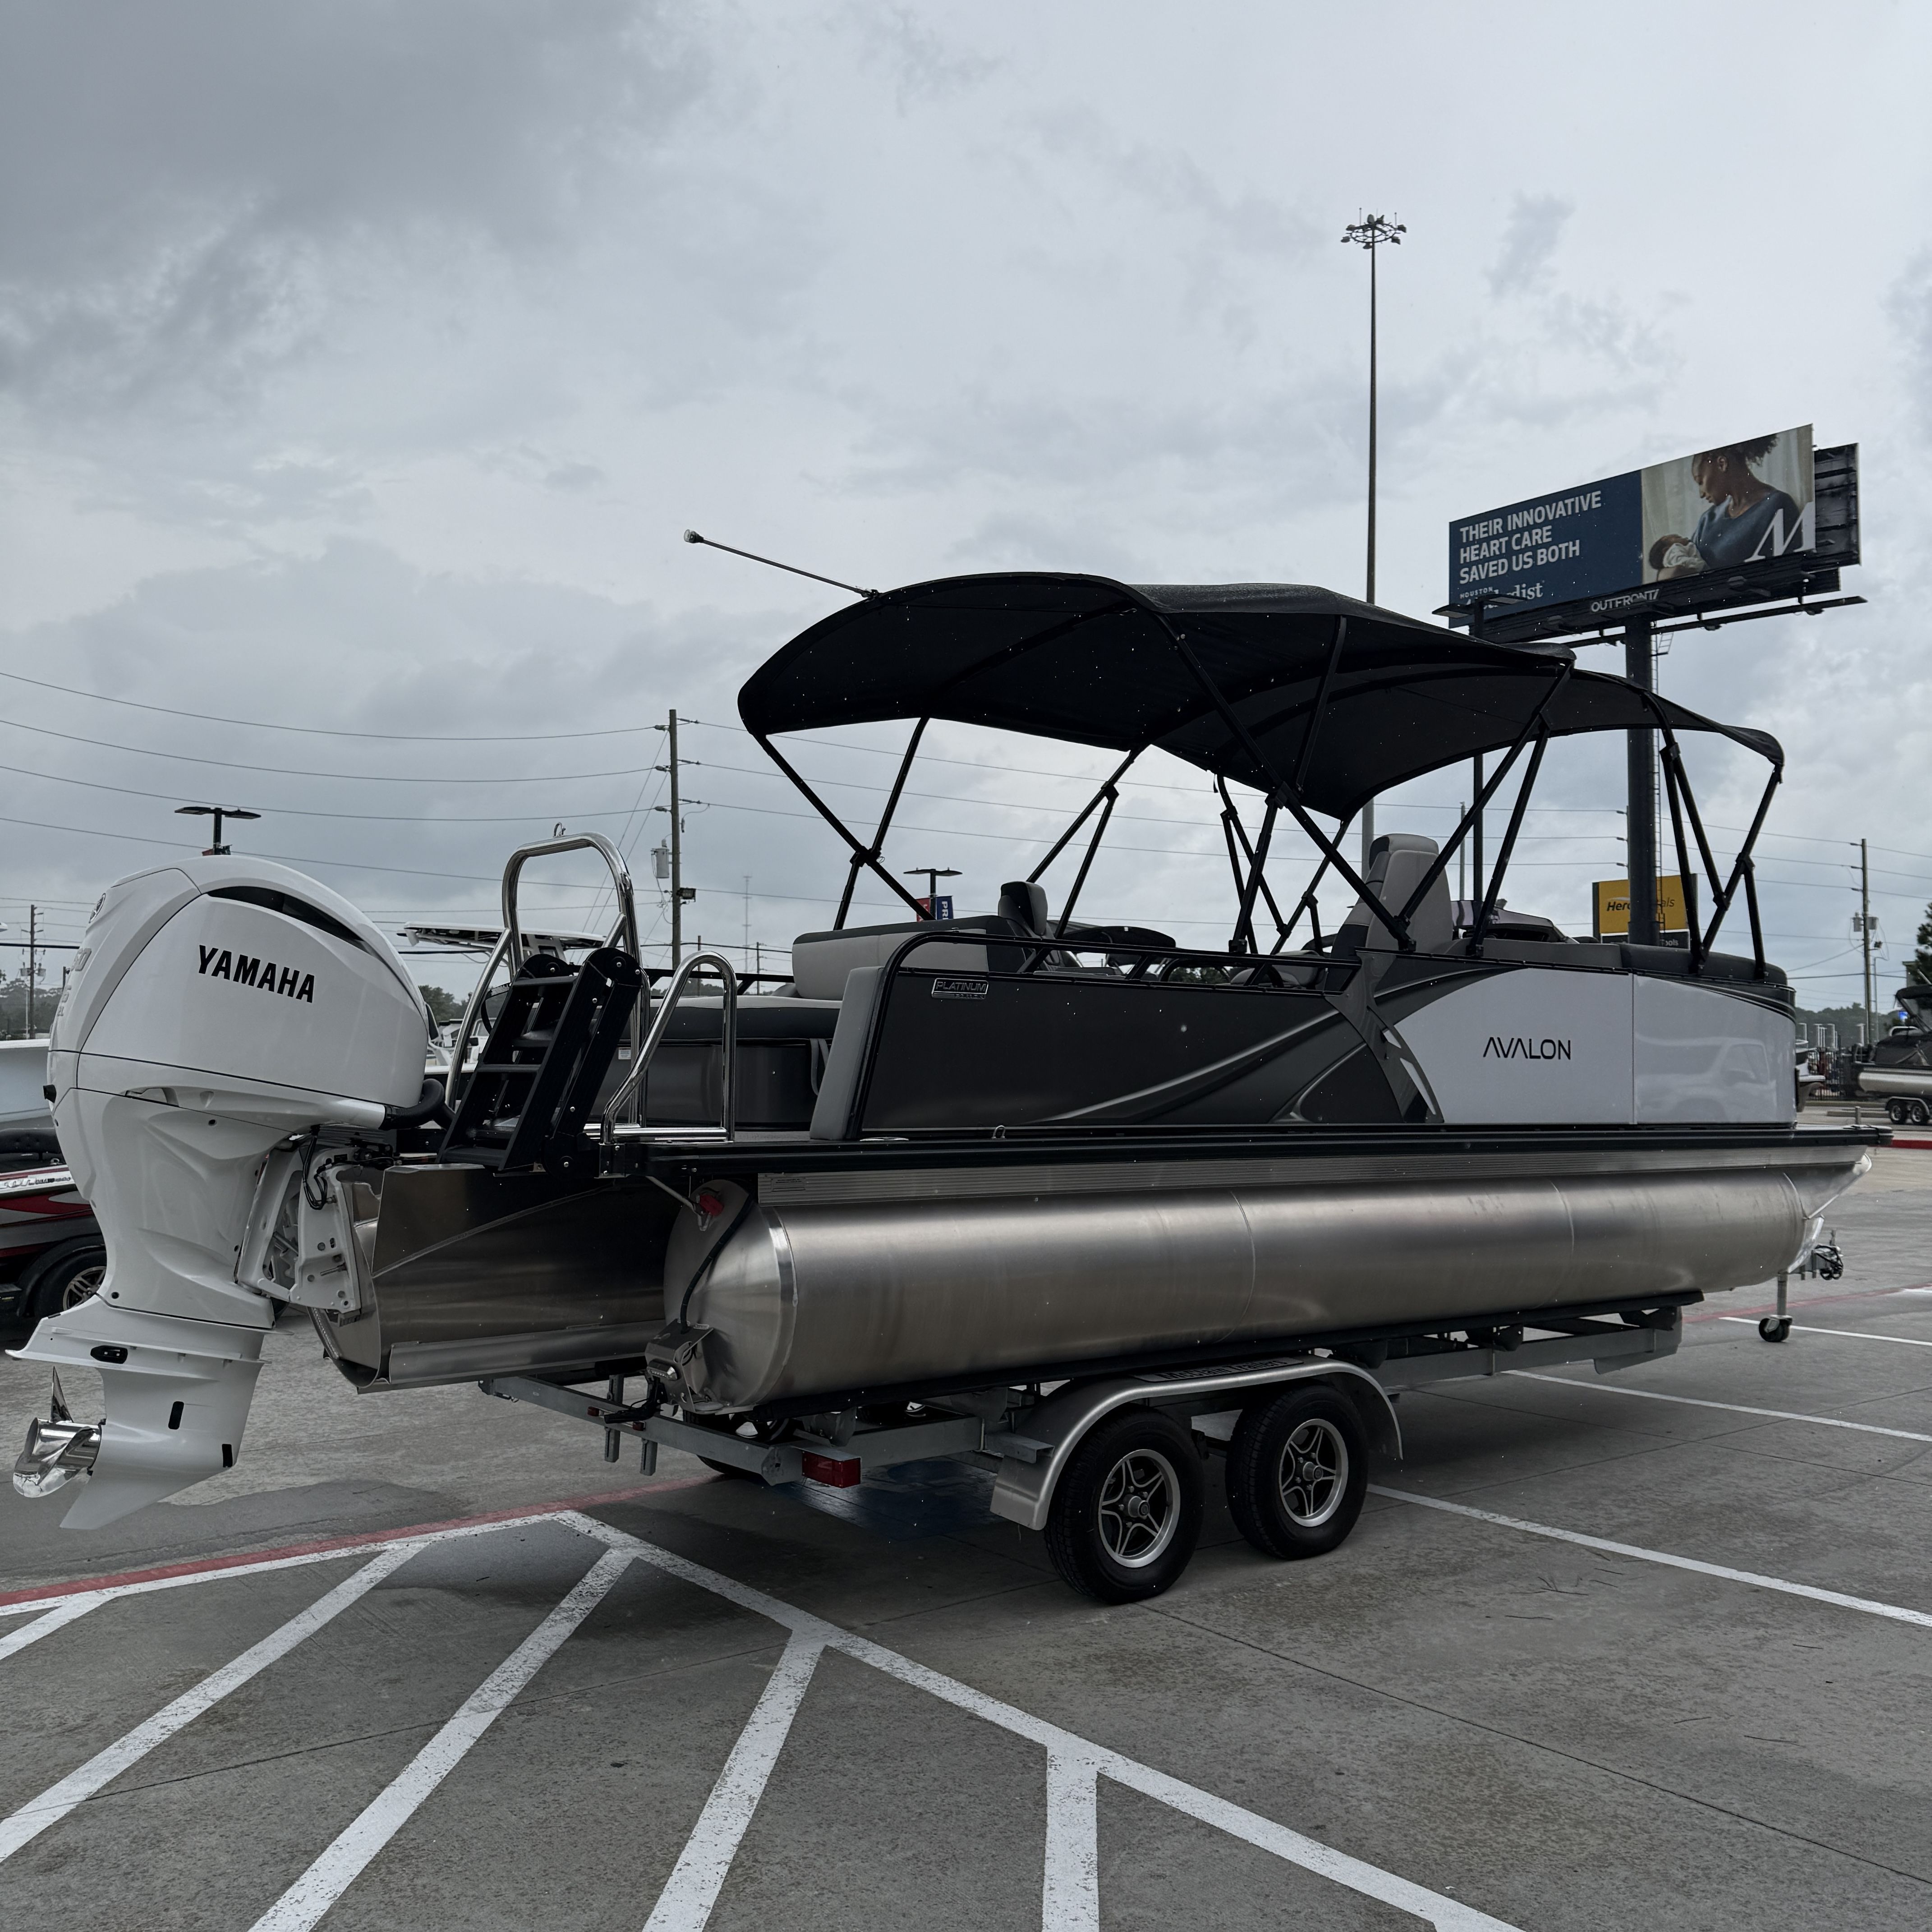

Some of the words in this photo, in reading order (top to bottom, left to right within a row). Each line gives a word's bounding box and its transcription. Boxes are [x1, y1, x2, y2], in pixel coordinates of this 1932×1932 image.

[1459, 518, 1504, 543] THEIR
[1508, 490, 1601, 531] INNOVATIVE
[1460, 537, 1509, 564] HEART
[1511, 525, 1552, 550] CARE
[1459, 558, 1509, 584] SAVED
[1512, 552, 1533, 571] US
[1537, 539, 1580, 566] BOTH
[1460, 586, 1493, 599] HOUSTON
[198, 945, 315, 1003] YAMAHA
[936, 981, 987, 992] PLATINUM
[1483, 1037, 1571, 1060] AVALON
[1156, 1367, 1228, 1380] McClain
[1230, 1360, 1288, 1371] Trailers
